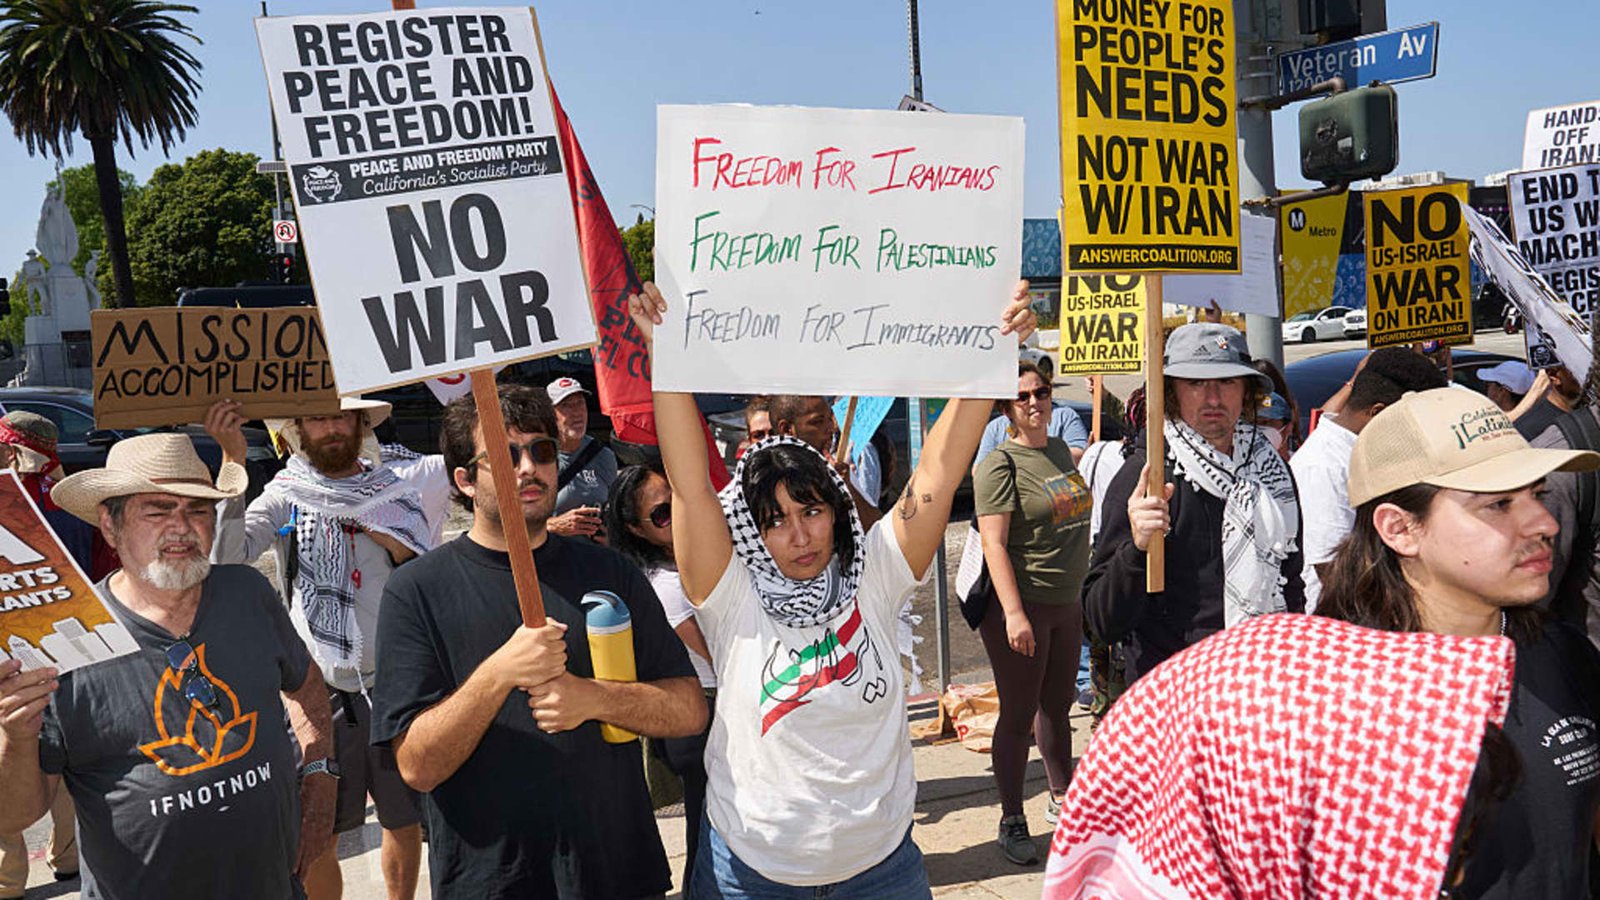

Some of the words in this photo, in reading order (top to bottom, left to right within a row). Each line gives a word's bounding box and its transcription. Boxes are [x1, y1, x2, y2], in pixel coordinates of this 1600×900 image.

[292, 15, 512, 67] REGISTER
[1073, 0, 1171, 29] MONEY
[1179, 3, 1225, 36] FOR
[1074, 24, 1225, 75] PEOPLE'S
[1288, 44, 1376, 79] Veteran
[1397, 32, 1427, 60] Av
[283, 61, 437, 113] PEACE
[451, 55, 534, 97] AND
[1075, 65, 1228, 127] NEEDS
[304, 96, 534, 158] FREEDOM!
[1553, 127, 1589, 147] OFF
[350, 158, 400, 178] PEACE
[402, 154, 434, 171] AND
[437, 145, 503, 166] FREEDOM
[507, 141, 548, 158] PARTY
[363, 171, 448, 194] California's
[450, 162, 509, 182] Socialist
[511, 158, 548, 176] Party
[692, 137, 803, 191] FREEDOM
[812, 147, 857, 191] FOR
[868, 147, 1001, 194] IRANIANS
[1077, 134, 1149, 182] NOT
[1155, 138, 1230, 186] WAR
[1522, 172, 1578, 206] END
[386, 192, 508, 284] NO
[689, 211, 802, 272] FREEDOM
[812, 225, 862, 272] FOR
[876, 228, 999, 273] PALESTINIANS
[1309, 225, 1337, 237] Metro
[1371, 192, 1462, 248] NO
[1529, 204, 1565, 235] US
[1079, 247, 1232, 264] ANSWERCOALITION.ORG
[1371, 240, 1461, 267] US-ISRAEL
[1067, 292, 1140, 311] US-ISRAEL
[1373, 264, 1461, 310] WAR
[361, 269, 560, 374] WAR
[684, 290, 780, 351] FREEDOM
[799, 304, 846, 345] FOR
[846, 303, 999, 351] IMMIGRANTS
[1067, 312, 1138, 345] WAR
[1374, 309, 1399, 331] ON
[1407, 301, 1464, 326] IRAN!
[97, 311, 330, 368] MISSION
[1065, 345, 1086, 361] ON
[1091, 343, 1138, 360] IRAN!
[98, 360, 336, 400] ACCOMPLISHED
[149, 762, 271, 817] IFNOTNOW
